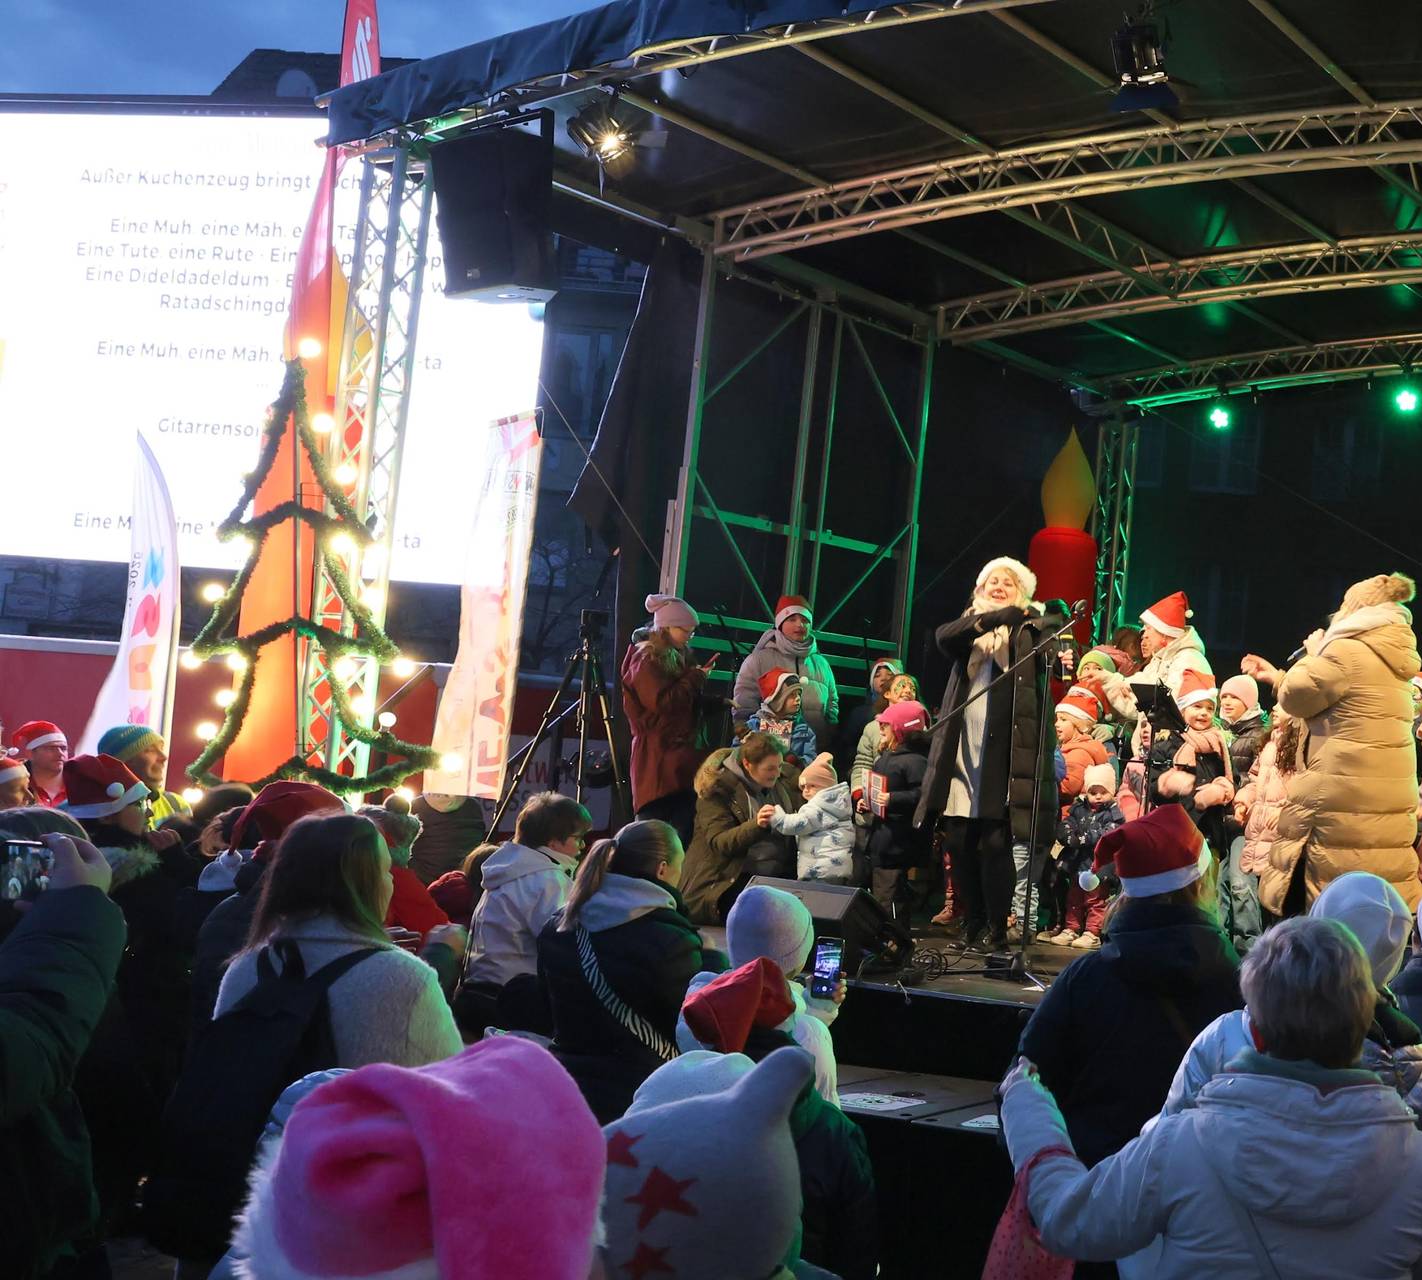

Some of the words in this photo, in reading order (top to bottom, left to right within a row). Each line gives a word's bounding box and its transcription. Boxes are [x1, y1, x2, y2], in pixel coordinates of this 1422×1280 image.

[138, 169, 249, 191] Kuchenzeug
[256, 170, 311, 192] bringt
[110, 217, 149, 234] Eine
[201, 220, 241, 237] eine
[77, 241, 115, 257] Eine
[168, 244, 208, 261] eine
[212, 245, 254, 263] Rute
[86, 266, 124, 283] Eine
[129, 268, 270, 289] Dideldadeldum
[97, 341, 136, 357] Eine
[188, 344, 227, 362] eine
[73, 512, 111, 529] Eine
